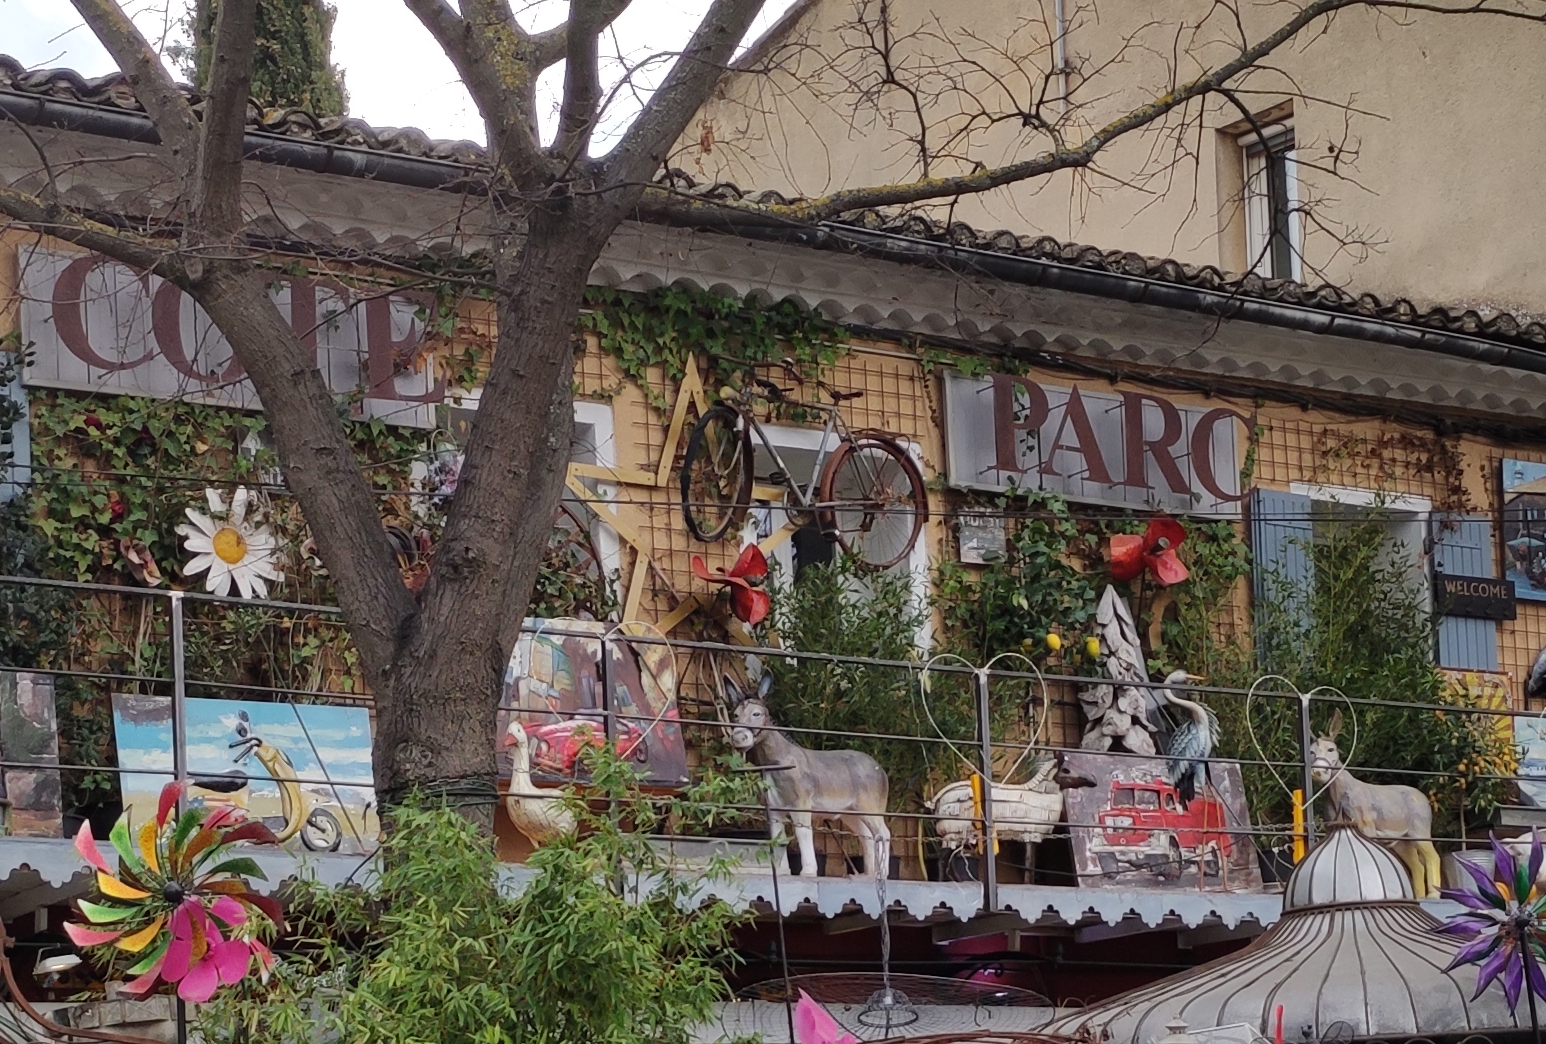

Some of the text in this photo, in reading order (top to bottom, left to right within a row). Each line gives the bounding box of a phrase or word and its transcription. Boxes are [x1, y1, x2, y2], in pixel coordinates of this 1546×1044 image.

[52, 254, 1258, 500] COTE PARC
[1444, 580, 1508, 599] WELCOME
